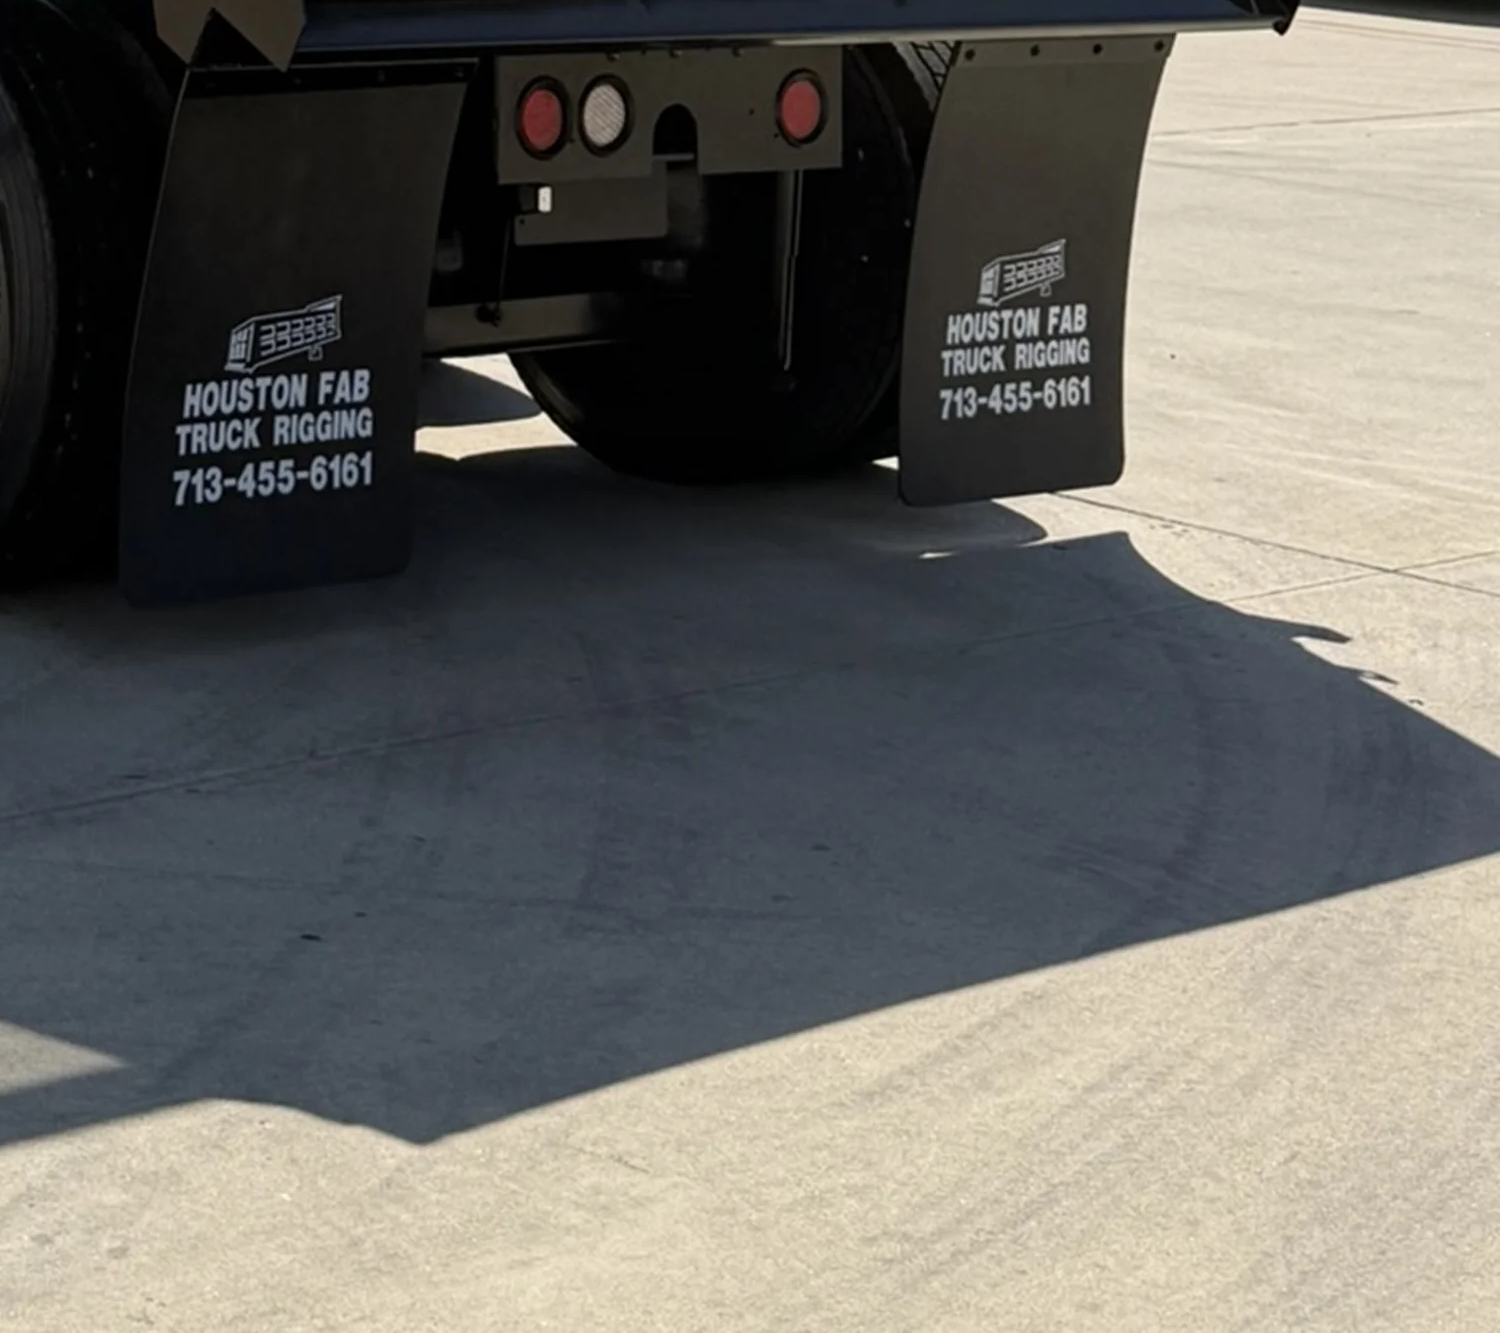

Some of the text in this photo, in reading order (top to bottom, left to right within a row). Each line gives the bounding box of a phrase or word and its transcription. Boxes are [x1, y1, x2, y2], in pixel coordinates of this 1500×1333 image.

[946, 303, 1088, 345] HOUSTON FAB
[941, 337, 1091, 377] TRUCK RIGGING
[183, 368, 371, 419] HOUSTON FAB
[939, 375, 1091, 420] 713-455-6161
[175, 407, 373, 457] TRUCK RIGGING
[173, 451, 373, 506] 713-455-6161
